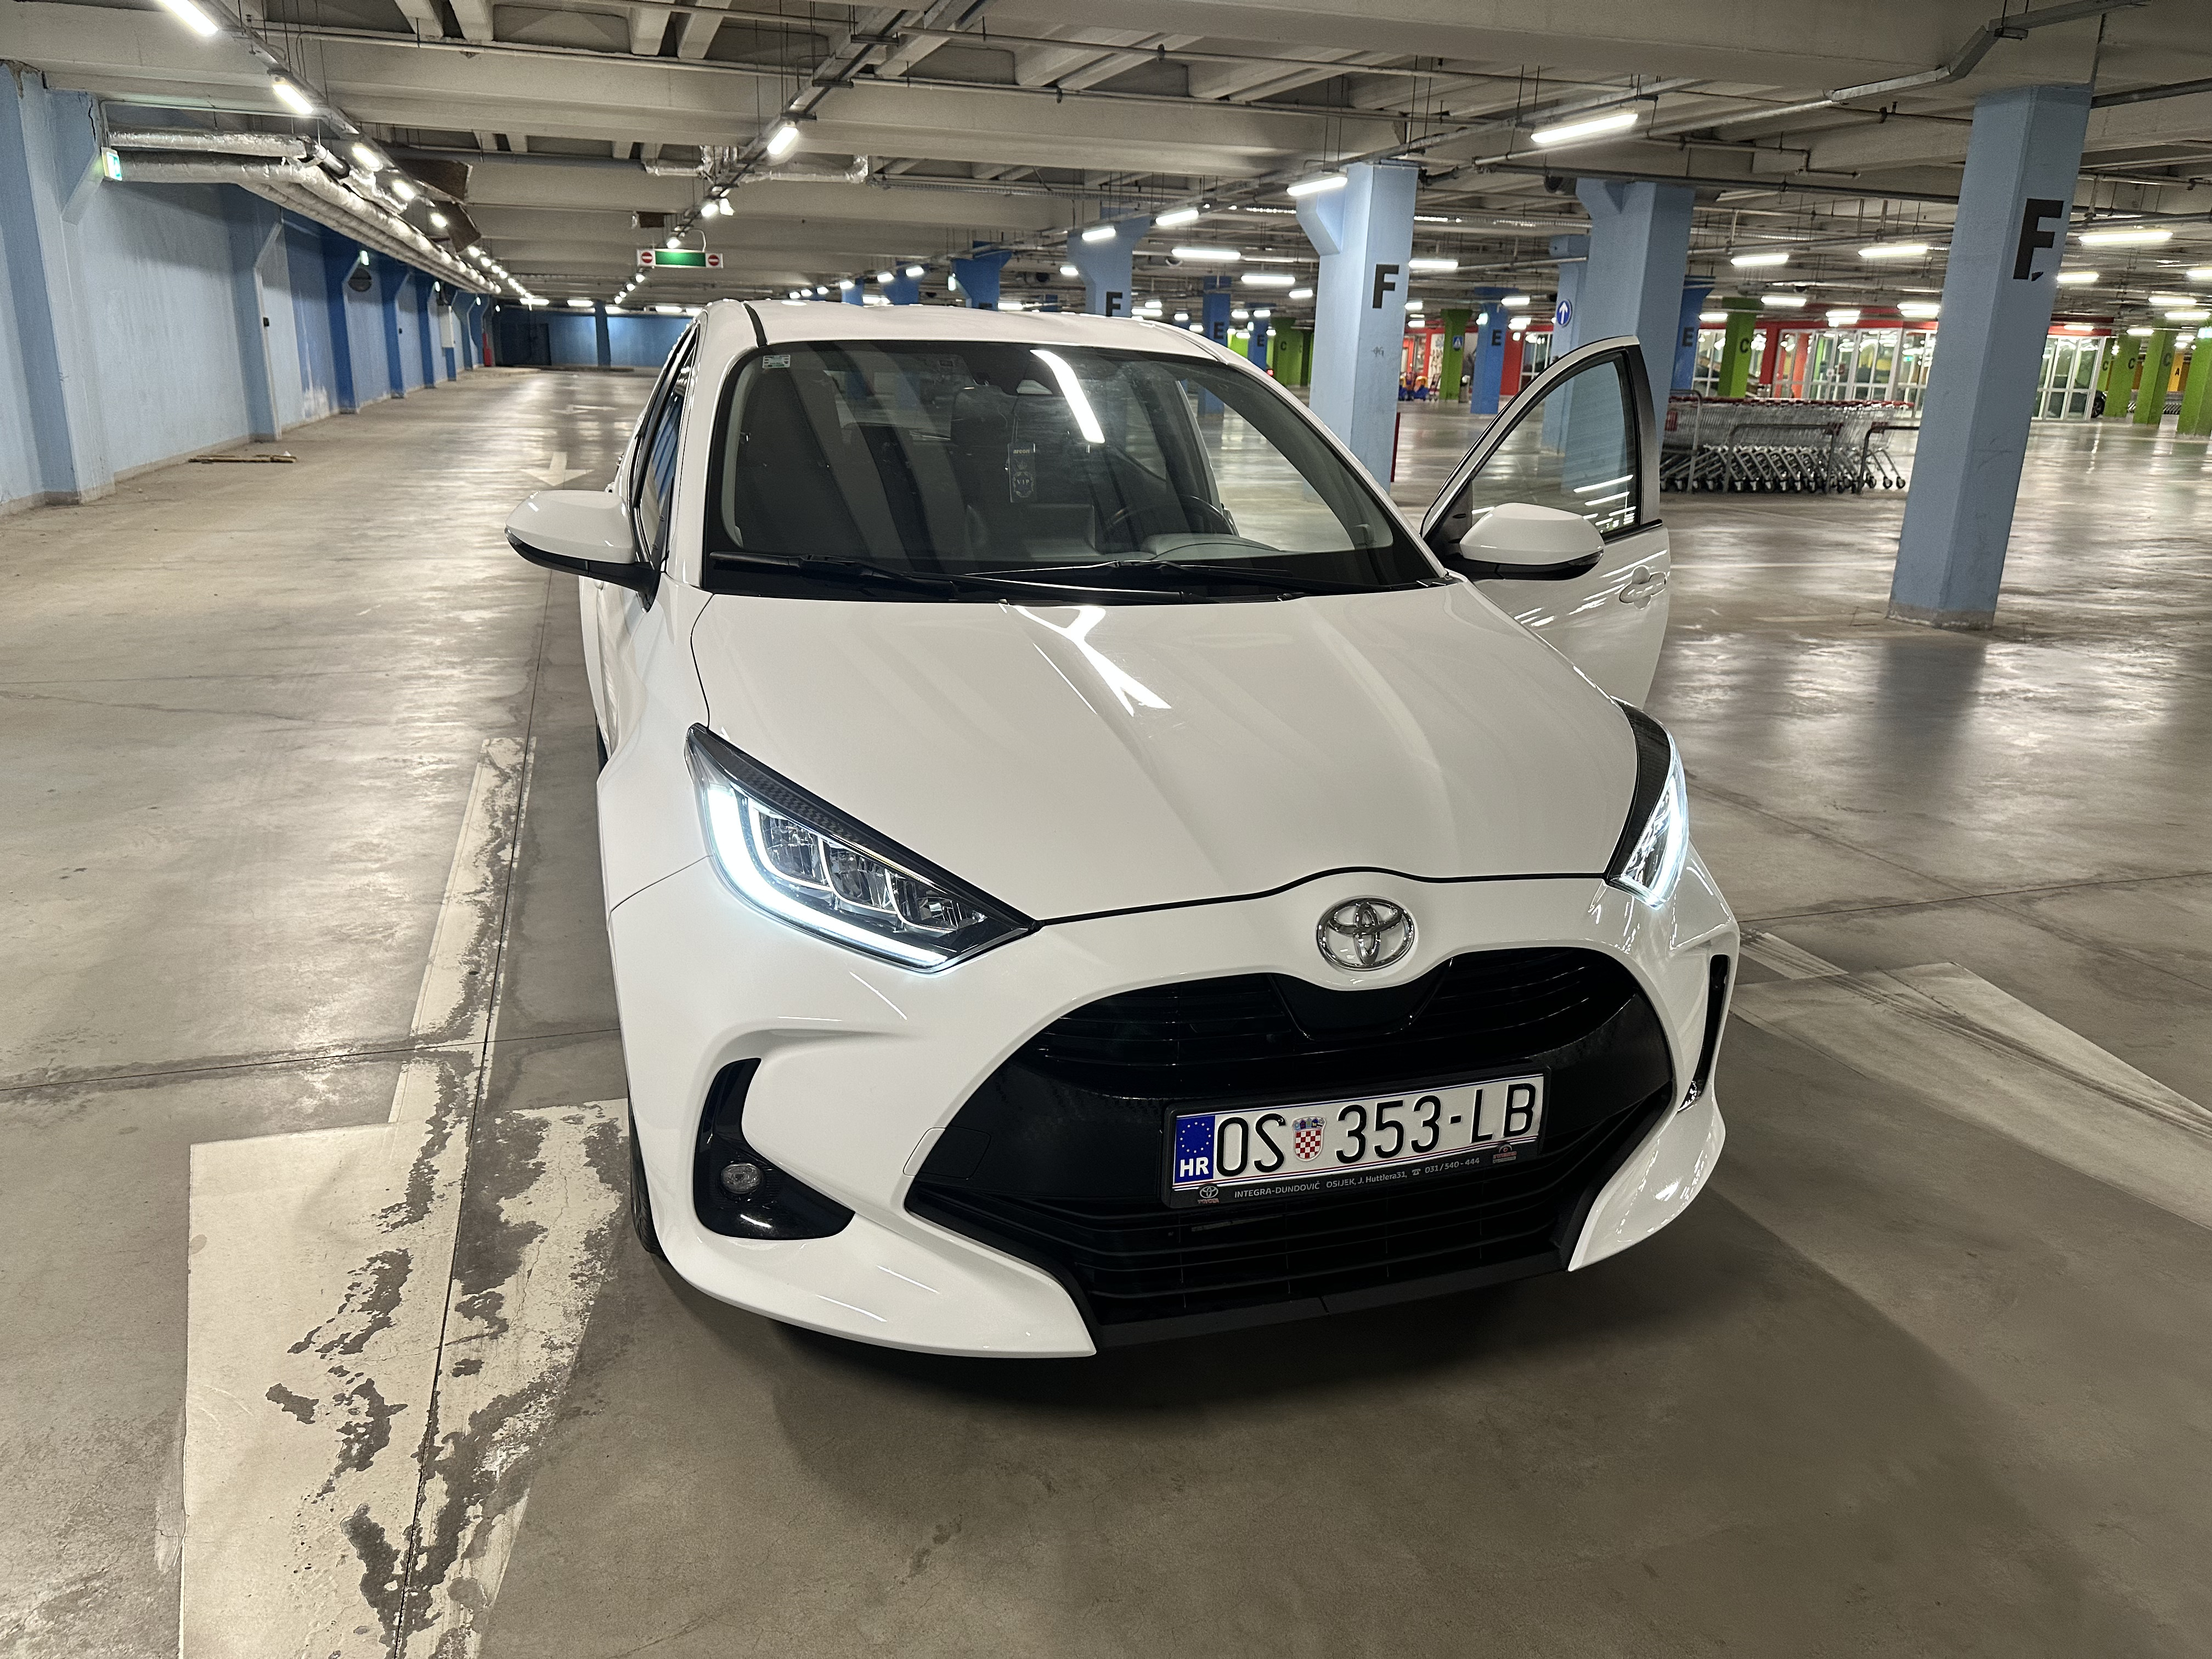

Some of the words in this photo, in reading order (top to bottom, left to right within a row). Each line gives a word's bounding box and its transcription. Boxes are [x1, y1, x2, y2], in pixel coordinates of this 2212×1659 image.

[2013, 198, 2064, 280] F
[1373, 264, 1399, 308] F
[1106, 291, 1122, 317] F
[1213, 321, 1224, 340] E
[1491, 329, 1502, 346] E
[1682, 326, 1694, 347] E
[1257, 334, 1265, 347] E
[1280, 341, 1287, 351] C
[1740, 337, 1750, 353] C
[2102, 361, 2109, 371] C
[2128, 358, 2136, 369] C
[2163, 352, 2171, 366] C
[2175, 368, 2180, 376] A
[1216, 1113, 1286, 1177] OS
[1335, 1082, 1536, 1164] 353-LB
[1180, 1156, 1209, 1177] HR
[1234, 1180, 1321, 1198] INTEGRA-DUNDOVIĆ
[1326, 1178, 1356, 1189] OSIJEK,
